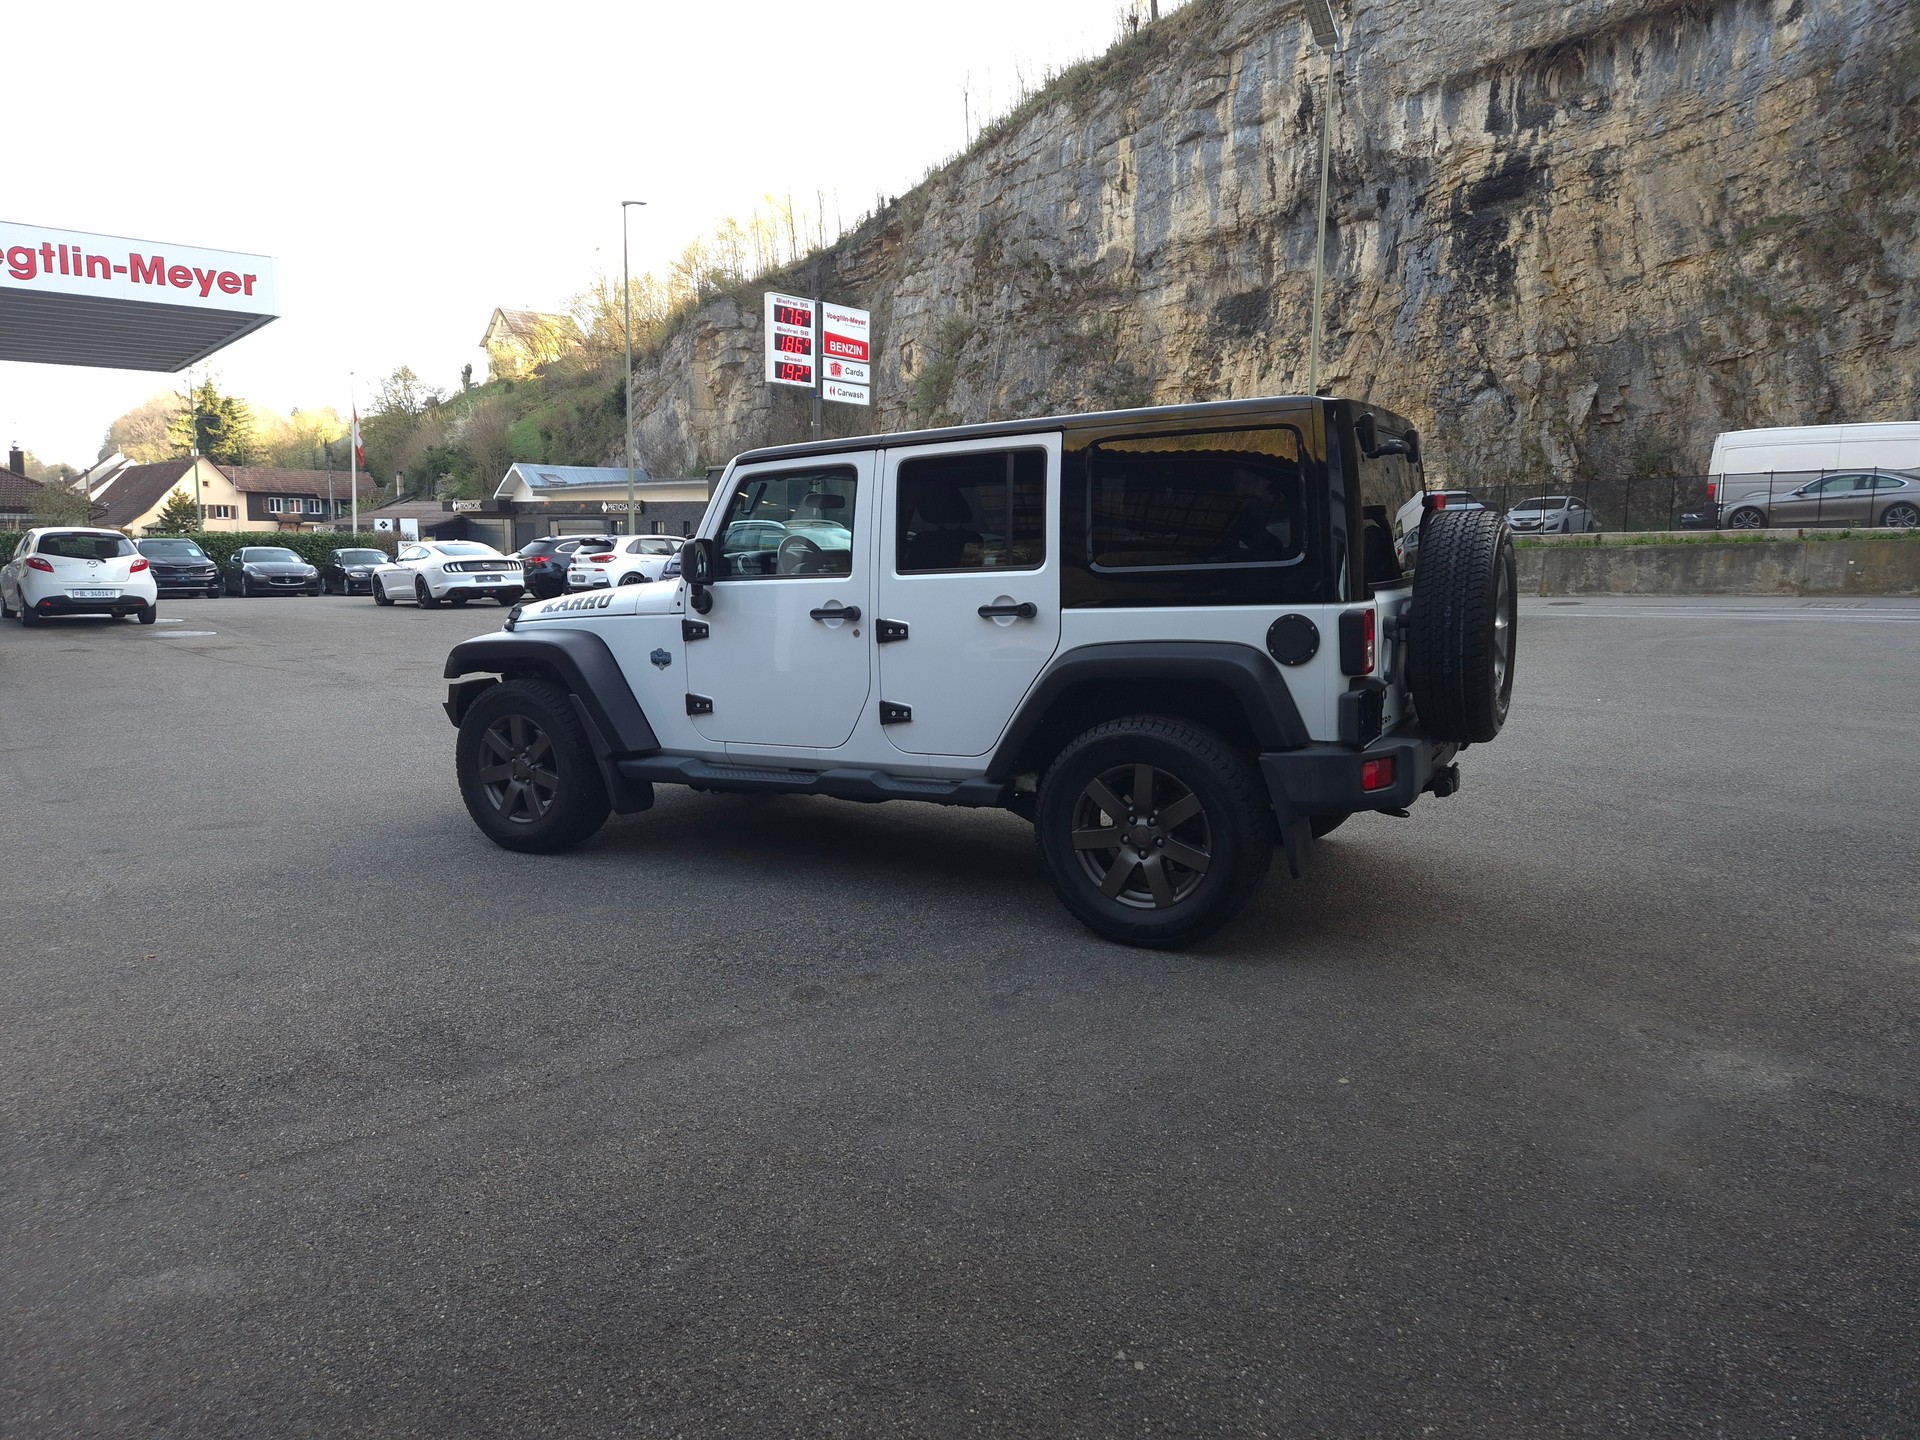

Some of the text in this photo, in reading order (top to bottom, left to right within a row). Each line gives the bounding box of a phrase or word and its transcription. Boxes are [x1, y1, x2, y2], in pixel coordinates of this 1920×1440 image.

[0, 242, 257, 298] gtlin-Meyer
[829, 341, 863, 356] BENZIN
[844, 367, 864, 378] Cards
[837, 388, 864, 399] Carwash
[540, 594, 615, 613] KARHU
